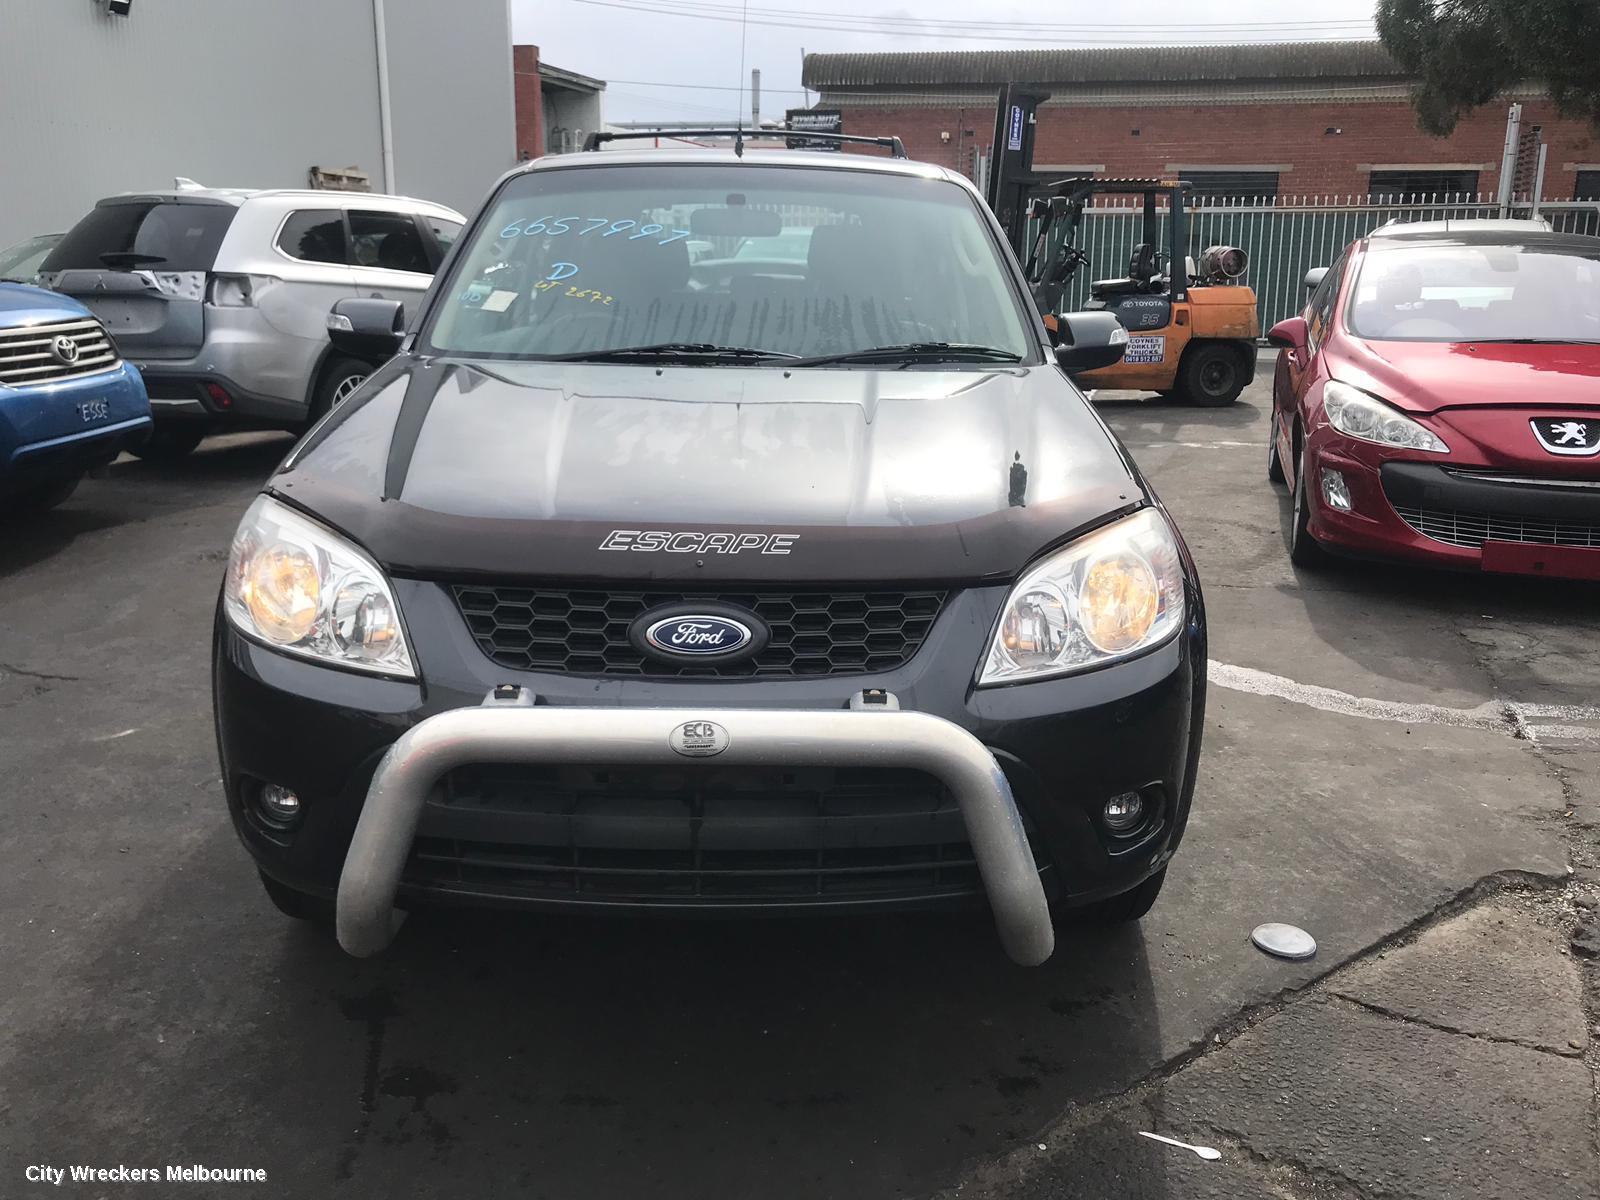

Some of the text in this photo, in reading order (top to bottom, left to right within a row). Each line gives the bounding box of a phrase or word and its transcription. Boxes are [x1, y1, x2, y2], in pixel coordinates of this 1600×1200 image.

[546, 262, 579, 280] D
[598, 529, 801, 555] ESCAPE
[671, 622, 725, 645] Ford
[683, 722, 715, 738] ECB
